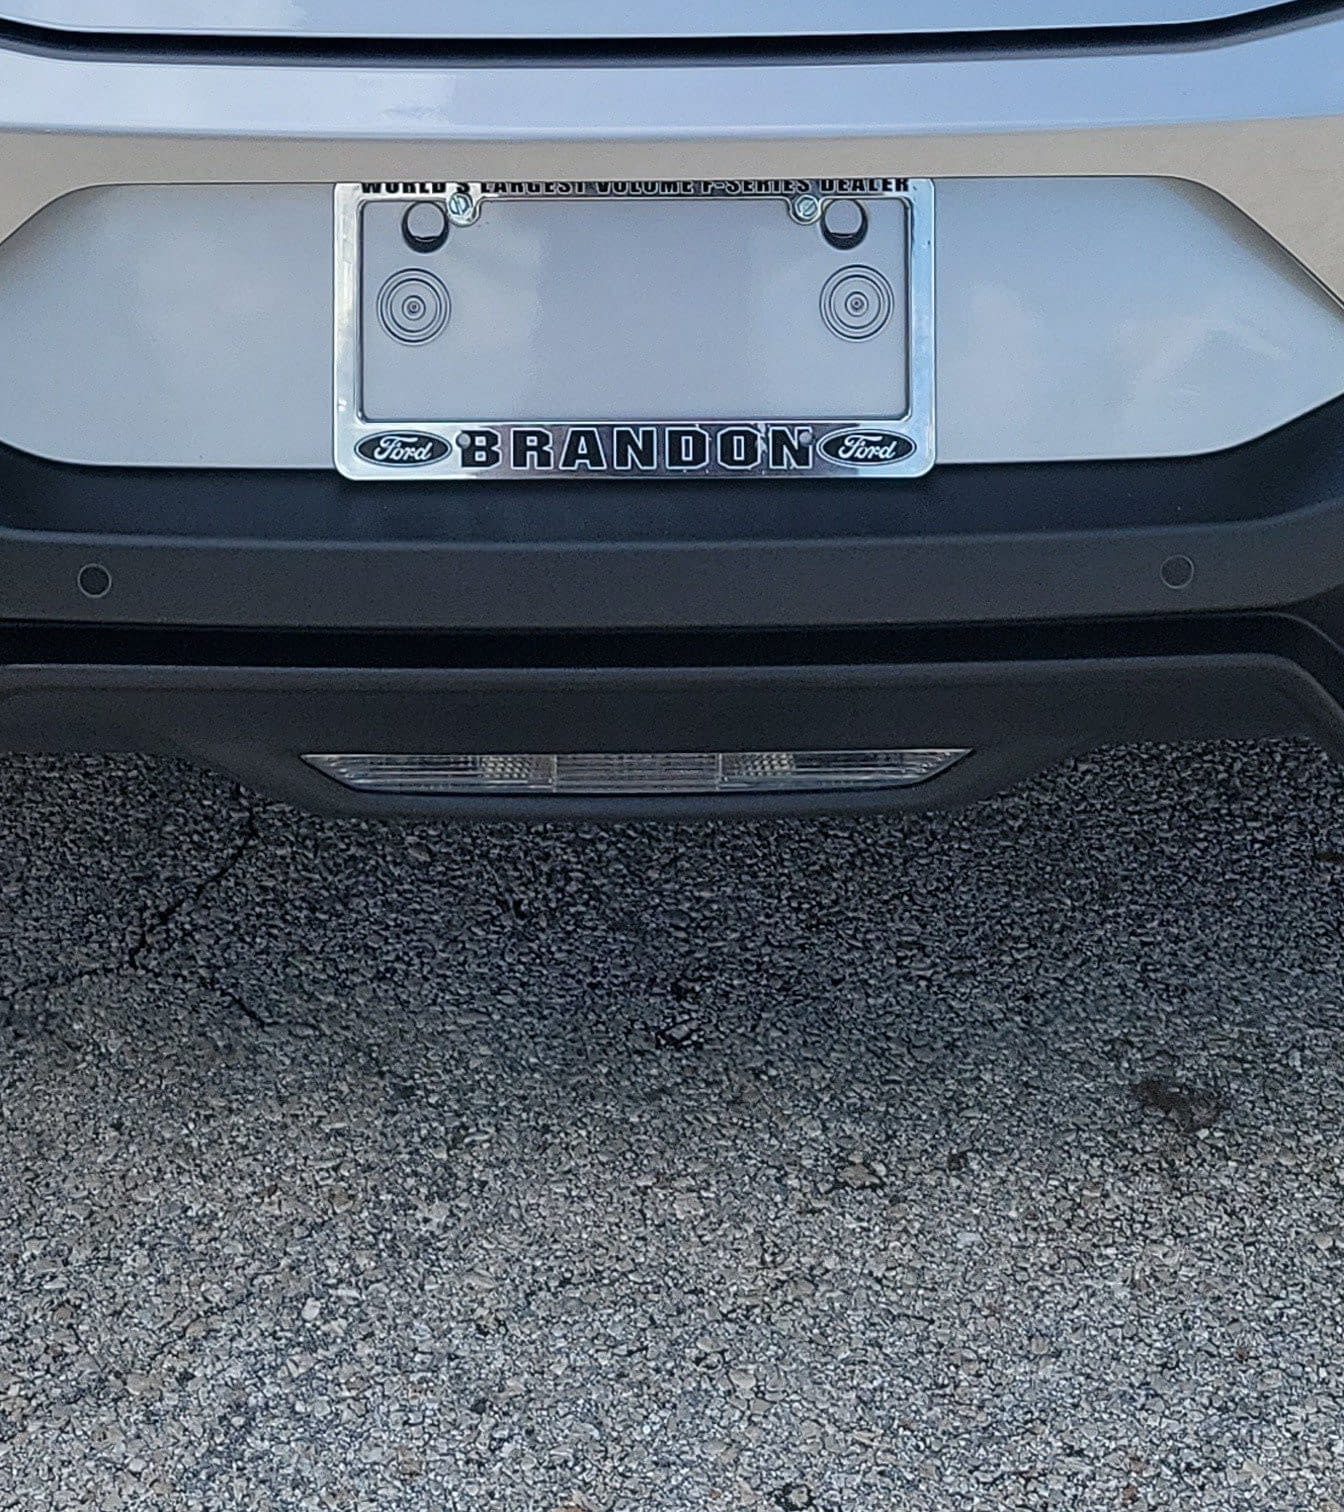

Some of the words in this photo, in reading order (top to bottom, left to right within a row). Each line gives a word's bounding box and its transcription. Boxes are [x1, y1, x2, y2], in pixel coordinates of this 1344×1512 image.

[373, 435, 432, 462] Ford
[458, 426, 813, 470] BRANDON
[837, 435, 897, 461] Ford
